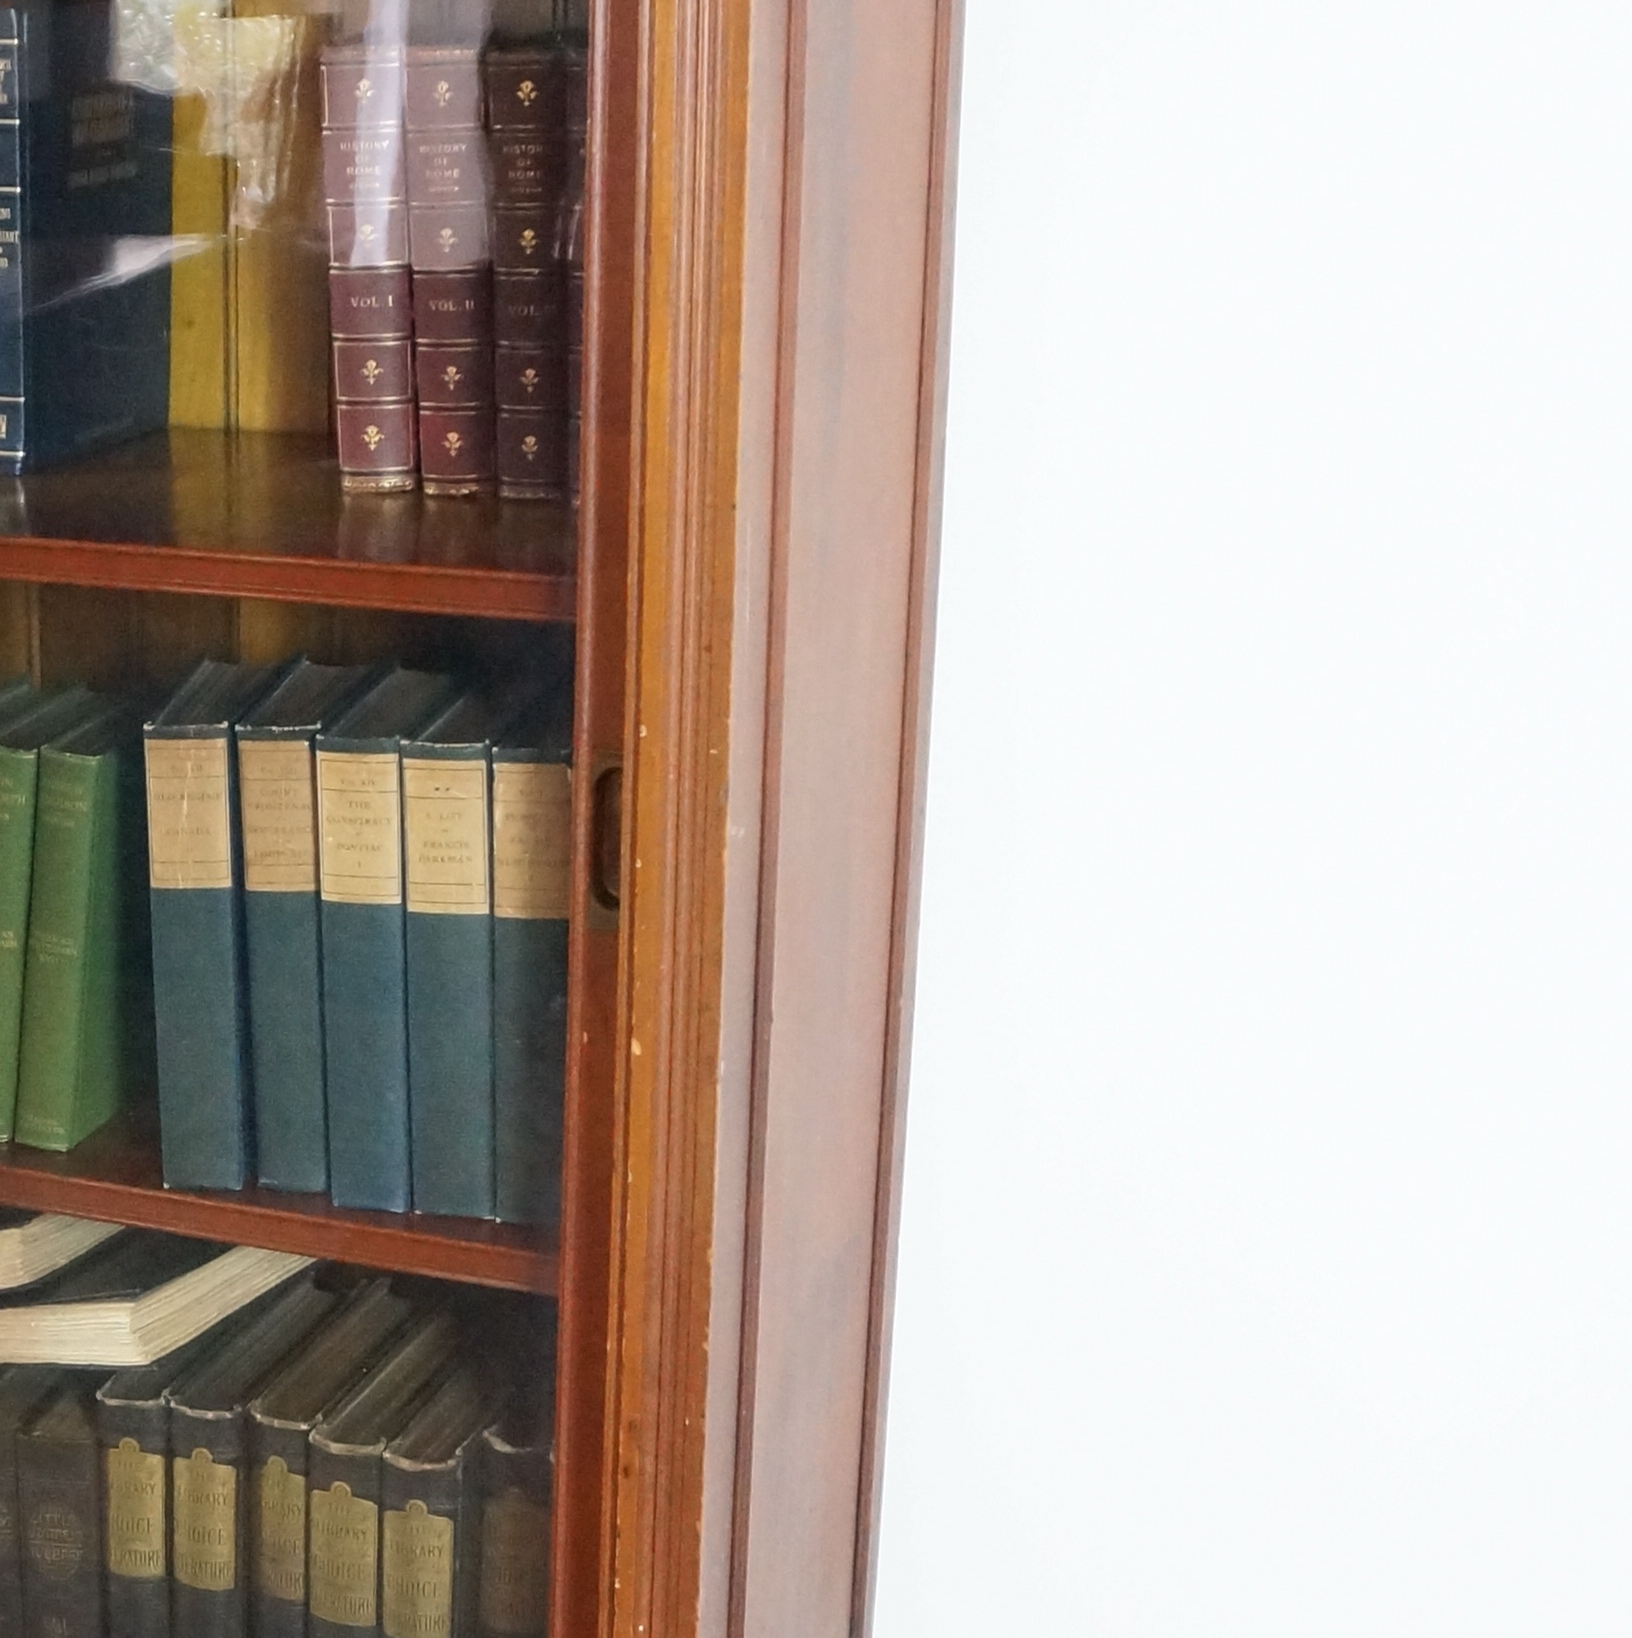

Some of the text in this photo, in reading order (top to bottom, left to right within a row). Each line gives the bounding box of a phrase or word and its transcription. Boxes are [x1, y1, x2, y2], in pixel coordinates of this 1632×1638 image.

[418, 144, 467, 154] HISTORY
[426, 168, 460, 178] ROME
[428, 299, 462, 311] VOL.
[346, 800, 372, 810] THE
